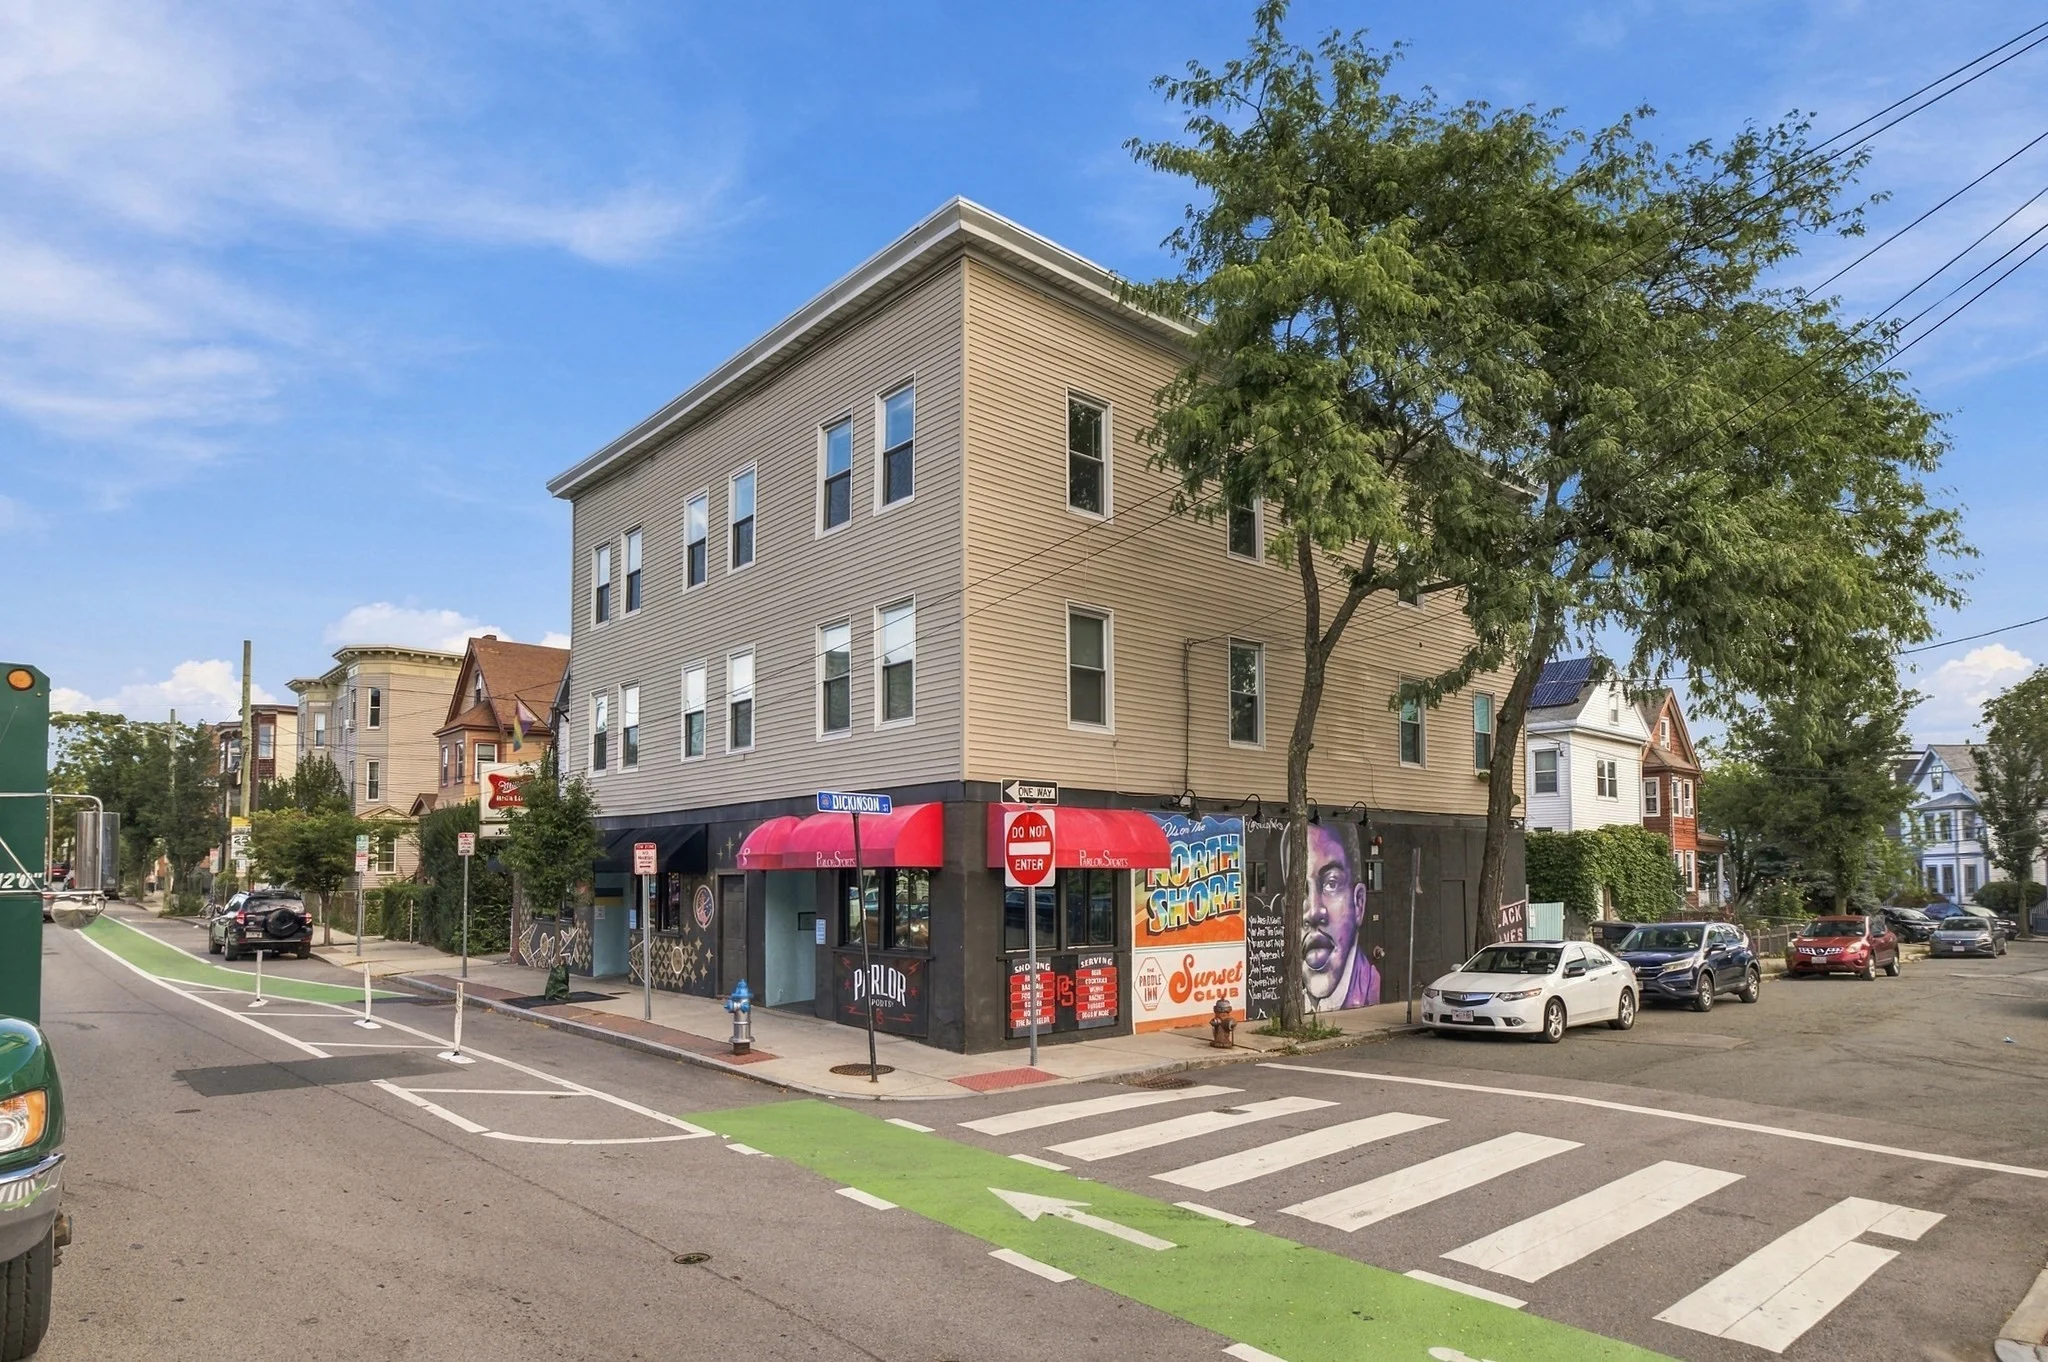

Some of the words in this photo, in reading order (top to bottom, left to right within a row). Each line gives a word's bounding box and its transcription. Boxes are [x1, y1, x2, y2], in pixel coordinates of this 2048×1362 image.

[1018, 786, 1034, 797] ONE
[1036, 788, 1052, 798] WAY
[832, 794, 880, 812] DICKINSON
[882, 803, 889, 812] ST
[1011, 827, 1025, 839] DO
[1029, 825, 1047, 838] NOT
[1179, 826, 1190, 834] on
[1188, 820, 1206, 833] The
[1015, 858, 1044, 871] ENTER
[1103, 850, 1129, 867] SPORTS
[1149, 872, 1241, 932] SHORE
[1498, 904, 1522, 928] ACK
[1015, 962, 1051, 973] SHOING
[1081, 957, 1113, 968] SERVING
[1139, 974, 1162, 987] PADDLE
[1168, 954, 1243, 1004] Sunset
[1144, 986, 1158, 1002] INN
[1193, 987, 1239, 1002] CLUB
[871, 998, 892, 1008] PORTS
[1015, 1019, 1025, 1028] THE
